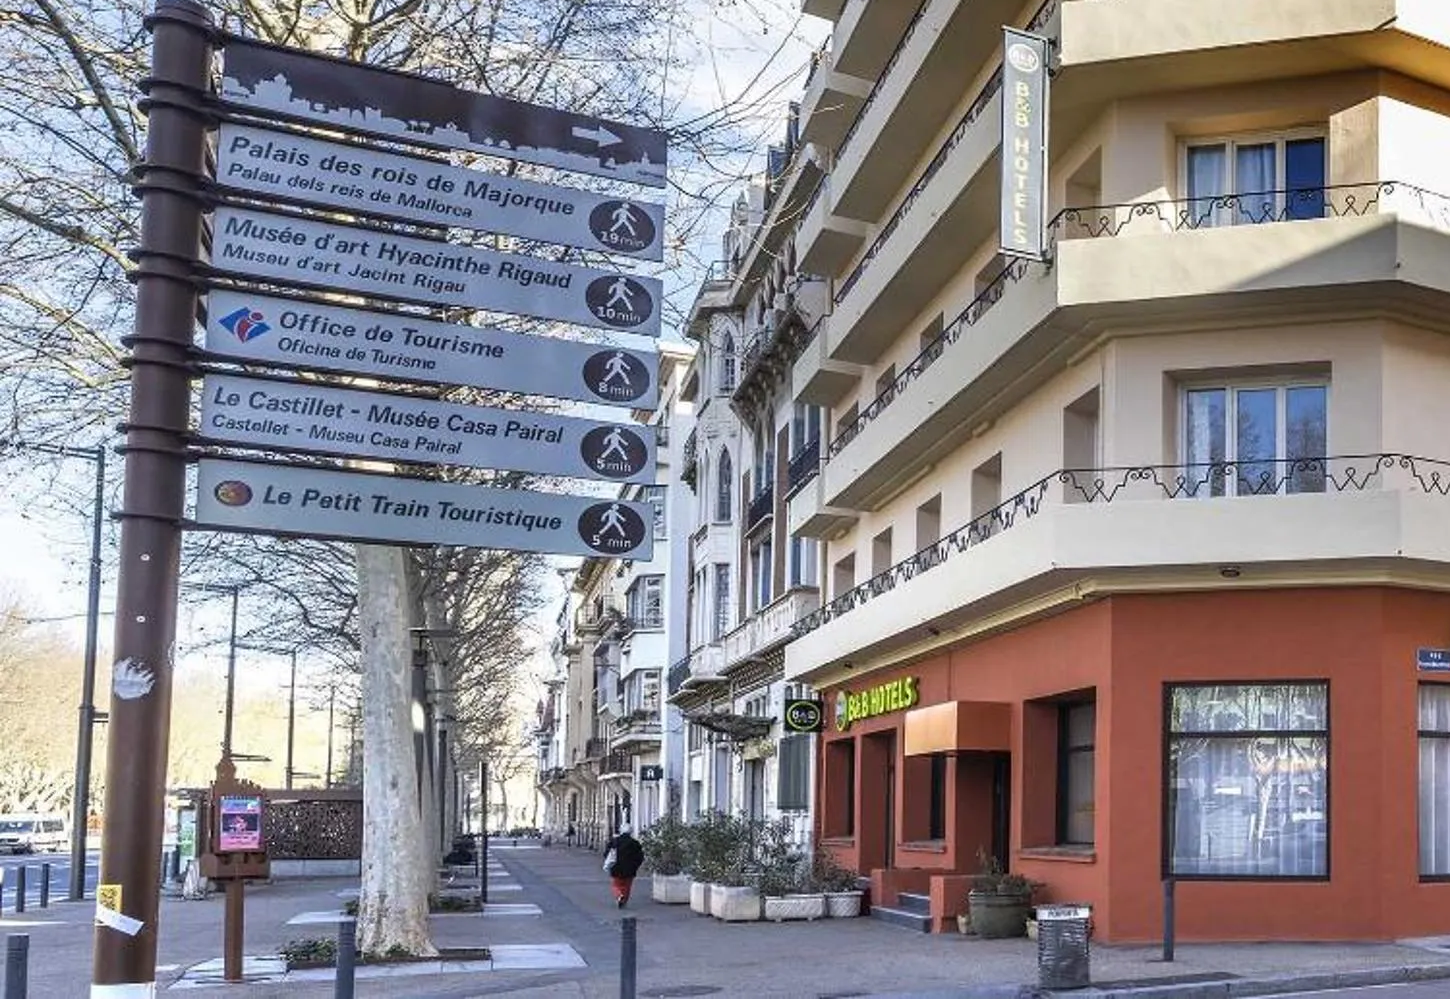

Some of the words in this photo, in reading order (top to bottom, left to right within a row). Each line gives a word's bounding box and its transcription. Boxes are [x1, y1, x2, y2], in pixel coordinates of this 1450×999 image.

[228, 163, 281, 184] Palau
[287, 174, 325, 192] dels
[330, 181, 365, 199] reis
[370, 188, 391, 203] de
[398, 193, 472, 218] Mallorca
[229, 136, 310, 167] Palais
[319, 154, 362, 176] des
[371, 166, 418, 186] rois
[427, 175, 454, 193] de
[464, 180, 576, 215] Majorque
[1014, 138, 1029, 245] HOTELS
[222, 243, 289, 266] Museu
[296, 256, 341, 274] d'art
[348, 264, 406, 284] Jacint
[413, 273, 466, 294] Rigau
[224, 217, 307, 246] Musée
[315, 233, 370, 257] d'art
[377, 242, 490, 275] Hyacinthe
[498, 261, 572, 288] Rigaud
[278, 337, 340, 359] Oficina
[346, 347, 366, 362] de
[372, 348, 435, 370] Turisme
[279, 311, 356, 337] Office
[364, 324, 393, 343] de
[402, 327, 504, 358] Tourisme
[598, 382, 607, 393] 8
[609, 385, 634, 397] min
[212, 414, 289, 436] Castellet
[309, 424, 365, 444] Museu
[370, 432, 409, 449] Casa
[415, 436, 462, 454] Pairal
[214, 386, 240, 406] Le
[248, 391, 345, 419] Castillet
[367, 404, 439, 430] Musée
[447, 414, 498, 436] Casa
[504, 420, 564, 444] Pairal
[596, 458, 606, 470] 5
[607, 461, 632, 473] min
[263, 485, 292, 505] Le
[301, 488, 362, 512] Petit
[371, 495, 429, 518] Train
[438, 502, 562, 532] Touristique
[592, 534, 601, 546] 5
[607, 537, 632, 548] min
[848, 691, 868, 721] B&B
[870, 677, 914, 716] HOTELS
